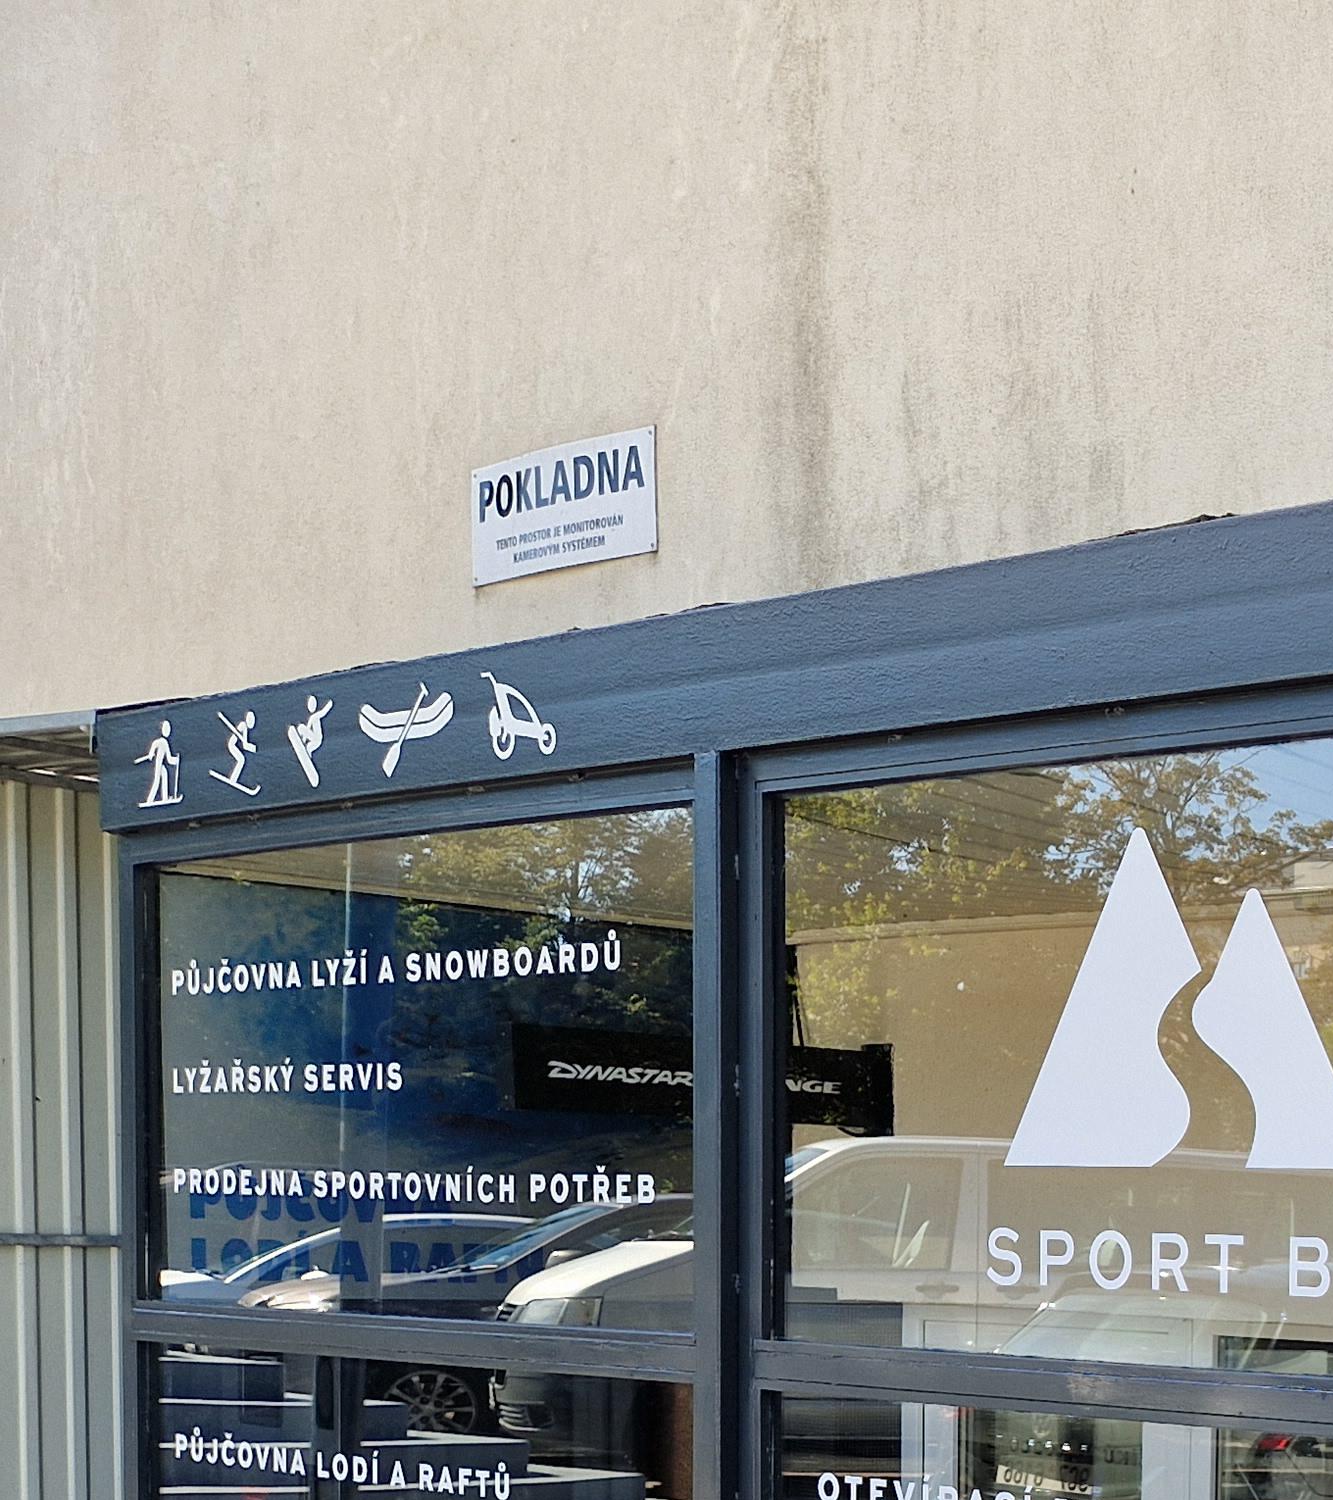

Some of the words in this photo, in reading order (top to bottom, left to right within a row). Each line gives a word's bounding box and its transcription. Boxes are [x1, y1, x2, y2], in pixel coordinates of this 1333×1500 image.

[479, 445, 645, 523] POKLADNA
[496, 537, 518, 551] TENTO
[519, 528, 552, 545] PROSTOR
[553, 525, 561, 538] JE
[563, 514, 624, 536] MONITOROVÁN
[513, 543, 560, 563] KAMEROVÝM
[562, 535, 606, 554] SYSTÉMEM
[171, 958, 302, 996] PŮJČOVNA
[311, 947, 368, 988] LYŽÍ
[378, 955, 395, 984] A
[406, 929, 622, 983] SNOWBOARDŮ
[172, 1057, 295, 1094] LYŽAŘSKÝ
[304, 1062, 403, 1092] SERVIS
[547, 1060, 693, 1087] DYNASTAR
[173, 1168, 303, 1197] PRODEJNA
[313, 1165, 515, 1204] SPORTOVNÍCH
[530, 1165, 656, 1204] POTŘEB
[331, 1240, 369, 1282] A
[986, 1226, 1245, 1294] SPORT
[174, 1426, 306, 1476] PŮJČOVNA
[317, 1450, 380, 1483] LODÍ
[390, 1459, 406, 1489] A
